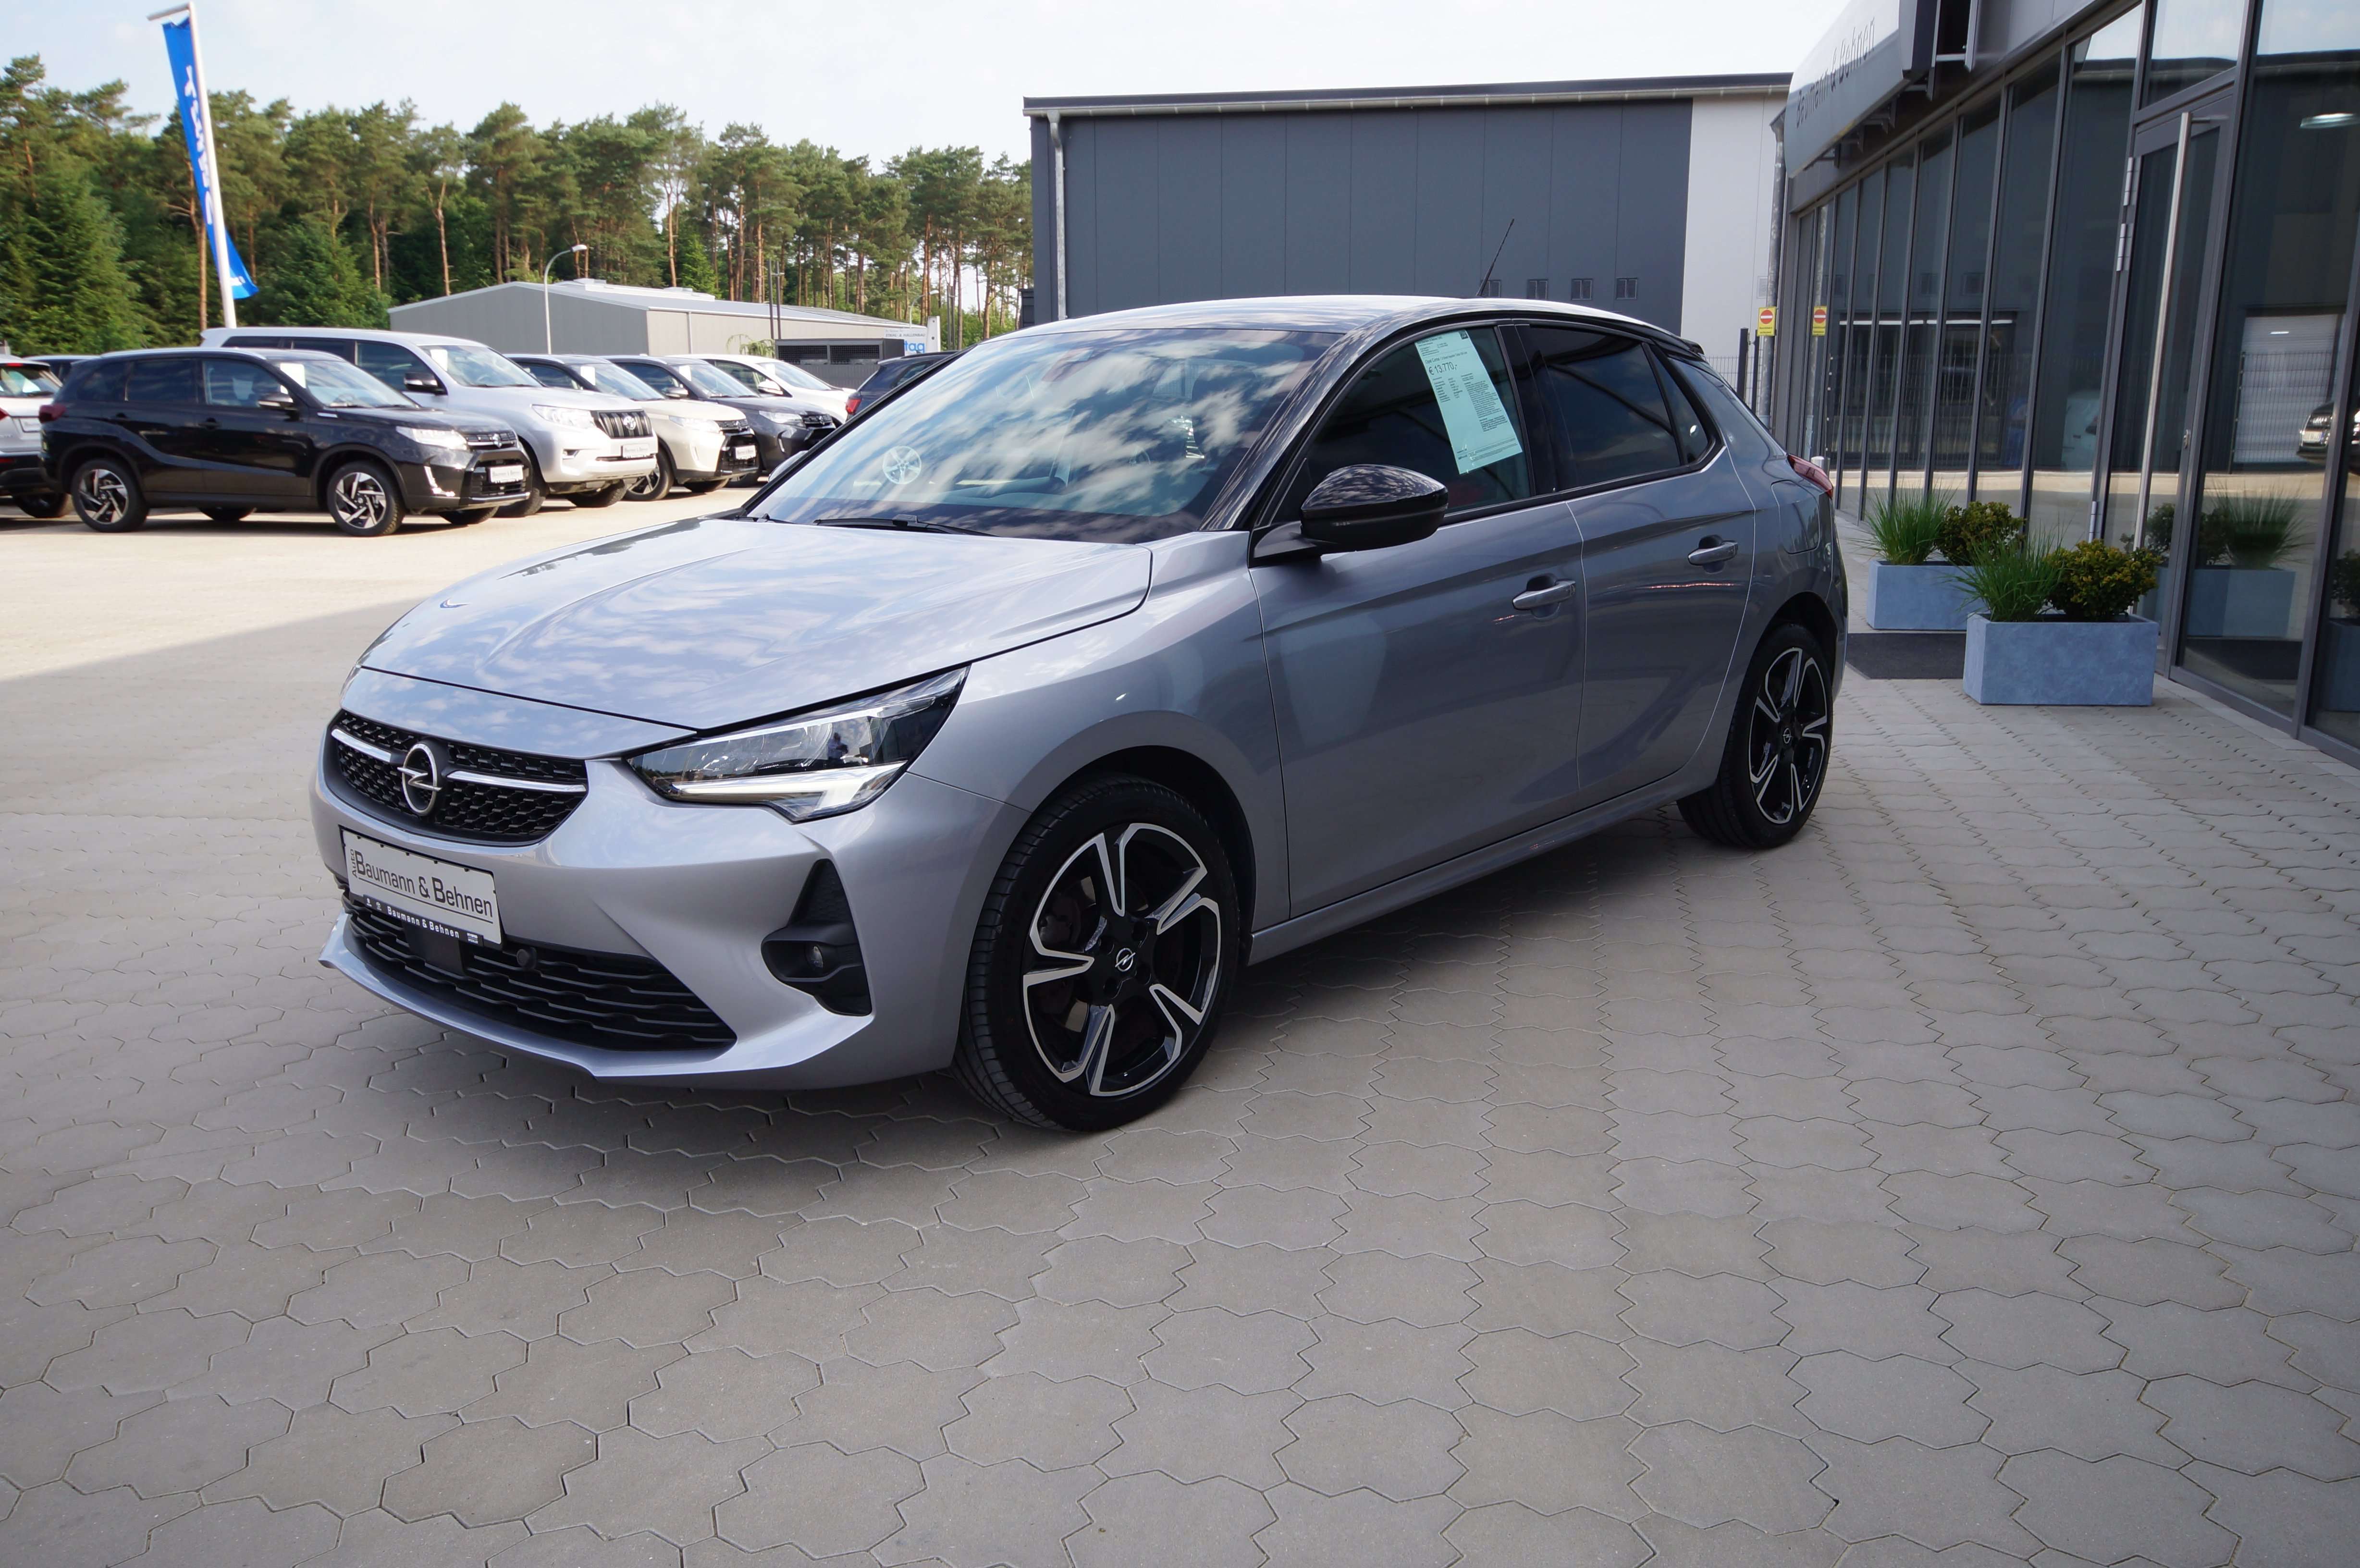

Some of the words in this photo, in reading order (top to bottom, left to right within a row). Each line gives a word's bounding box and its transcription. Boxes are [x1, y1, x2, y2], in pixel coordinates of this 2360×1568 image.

[1429, 366, 1435, 375] €
[355, 850, 416, 894] Baumann
[418, 876, 430, 899] &
[431, 876, 493, 918] Behnen
[387, 906, 420, 926] Baumann
[422, 919, 428, 928] &
[429, 921, 459, 938] Behnen
